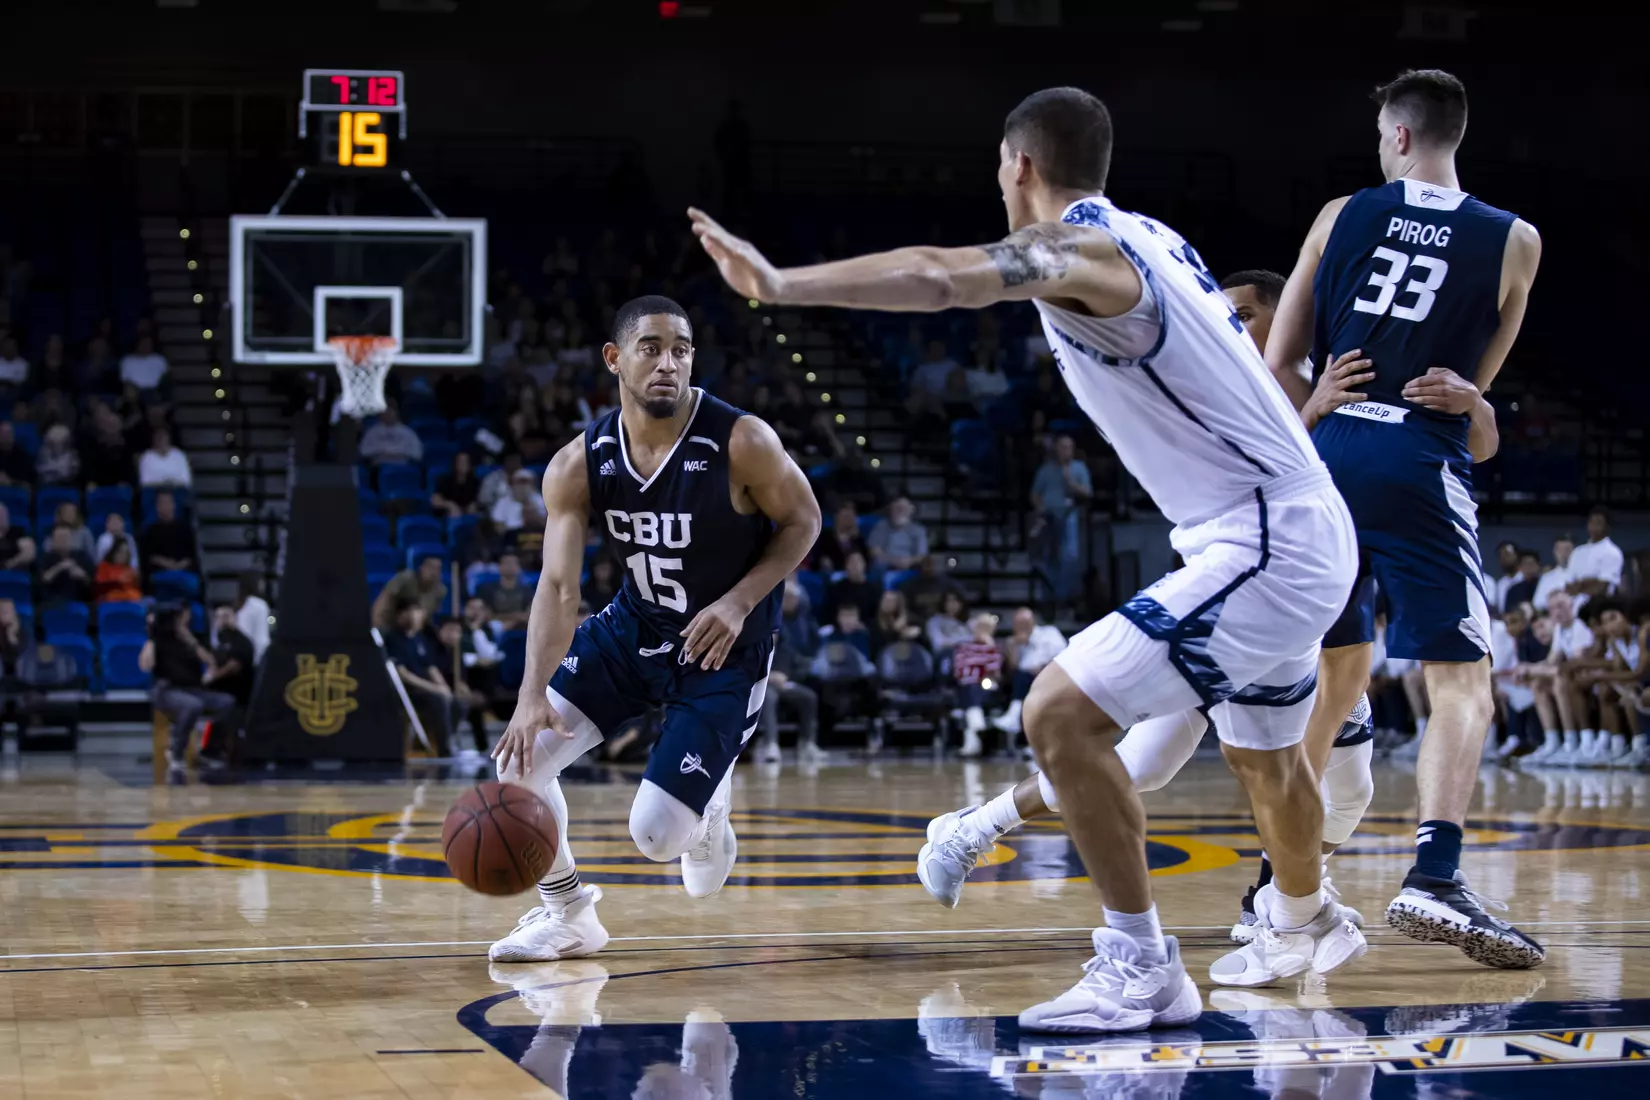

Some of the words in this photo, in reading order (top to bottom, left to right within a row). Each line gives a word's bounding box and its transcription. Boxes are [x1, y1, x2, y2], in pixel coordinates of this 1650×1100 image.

[338, 111, 387, 167] 15
[1386, 216, 1452, 248] PIROG
[1353, 245, 1449, 322] 33
[684, 460, 708, 472] WAC
[604, 509, 692, 549] CBU
[626, 551, 688, 613] 15
